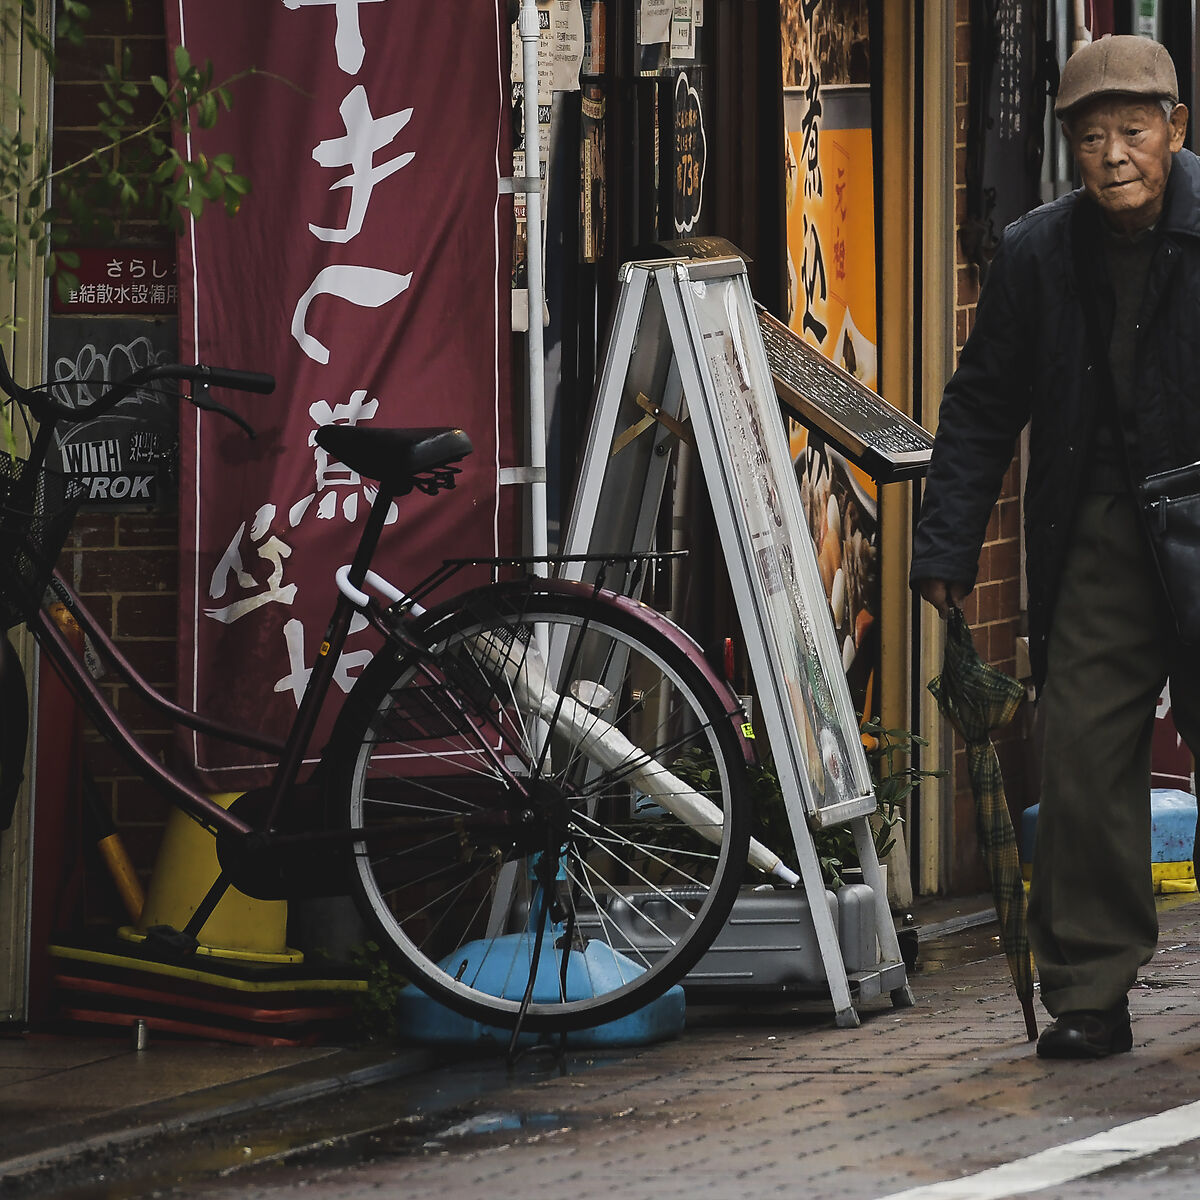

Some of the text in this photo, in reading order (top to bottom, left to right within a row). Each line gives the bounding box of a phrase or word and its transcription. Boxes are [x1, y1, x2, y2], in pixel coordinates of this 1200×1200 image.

[107, 258, 177, 279] さらし
[62, 440, 122, 473] WITH
